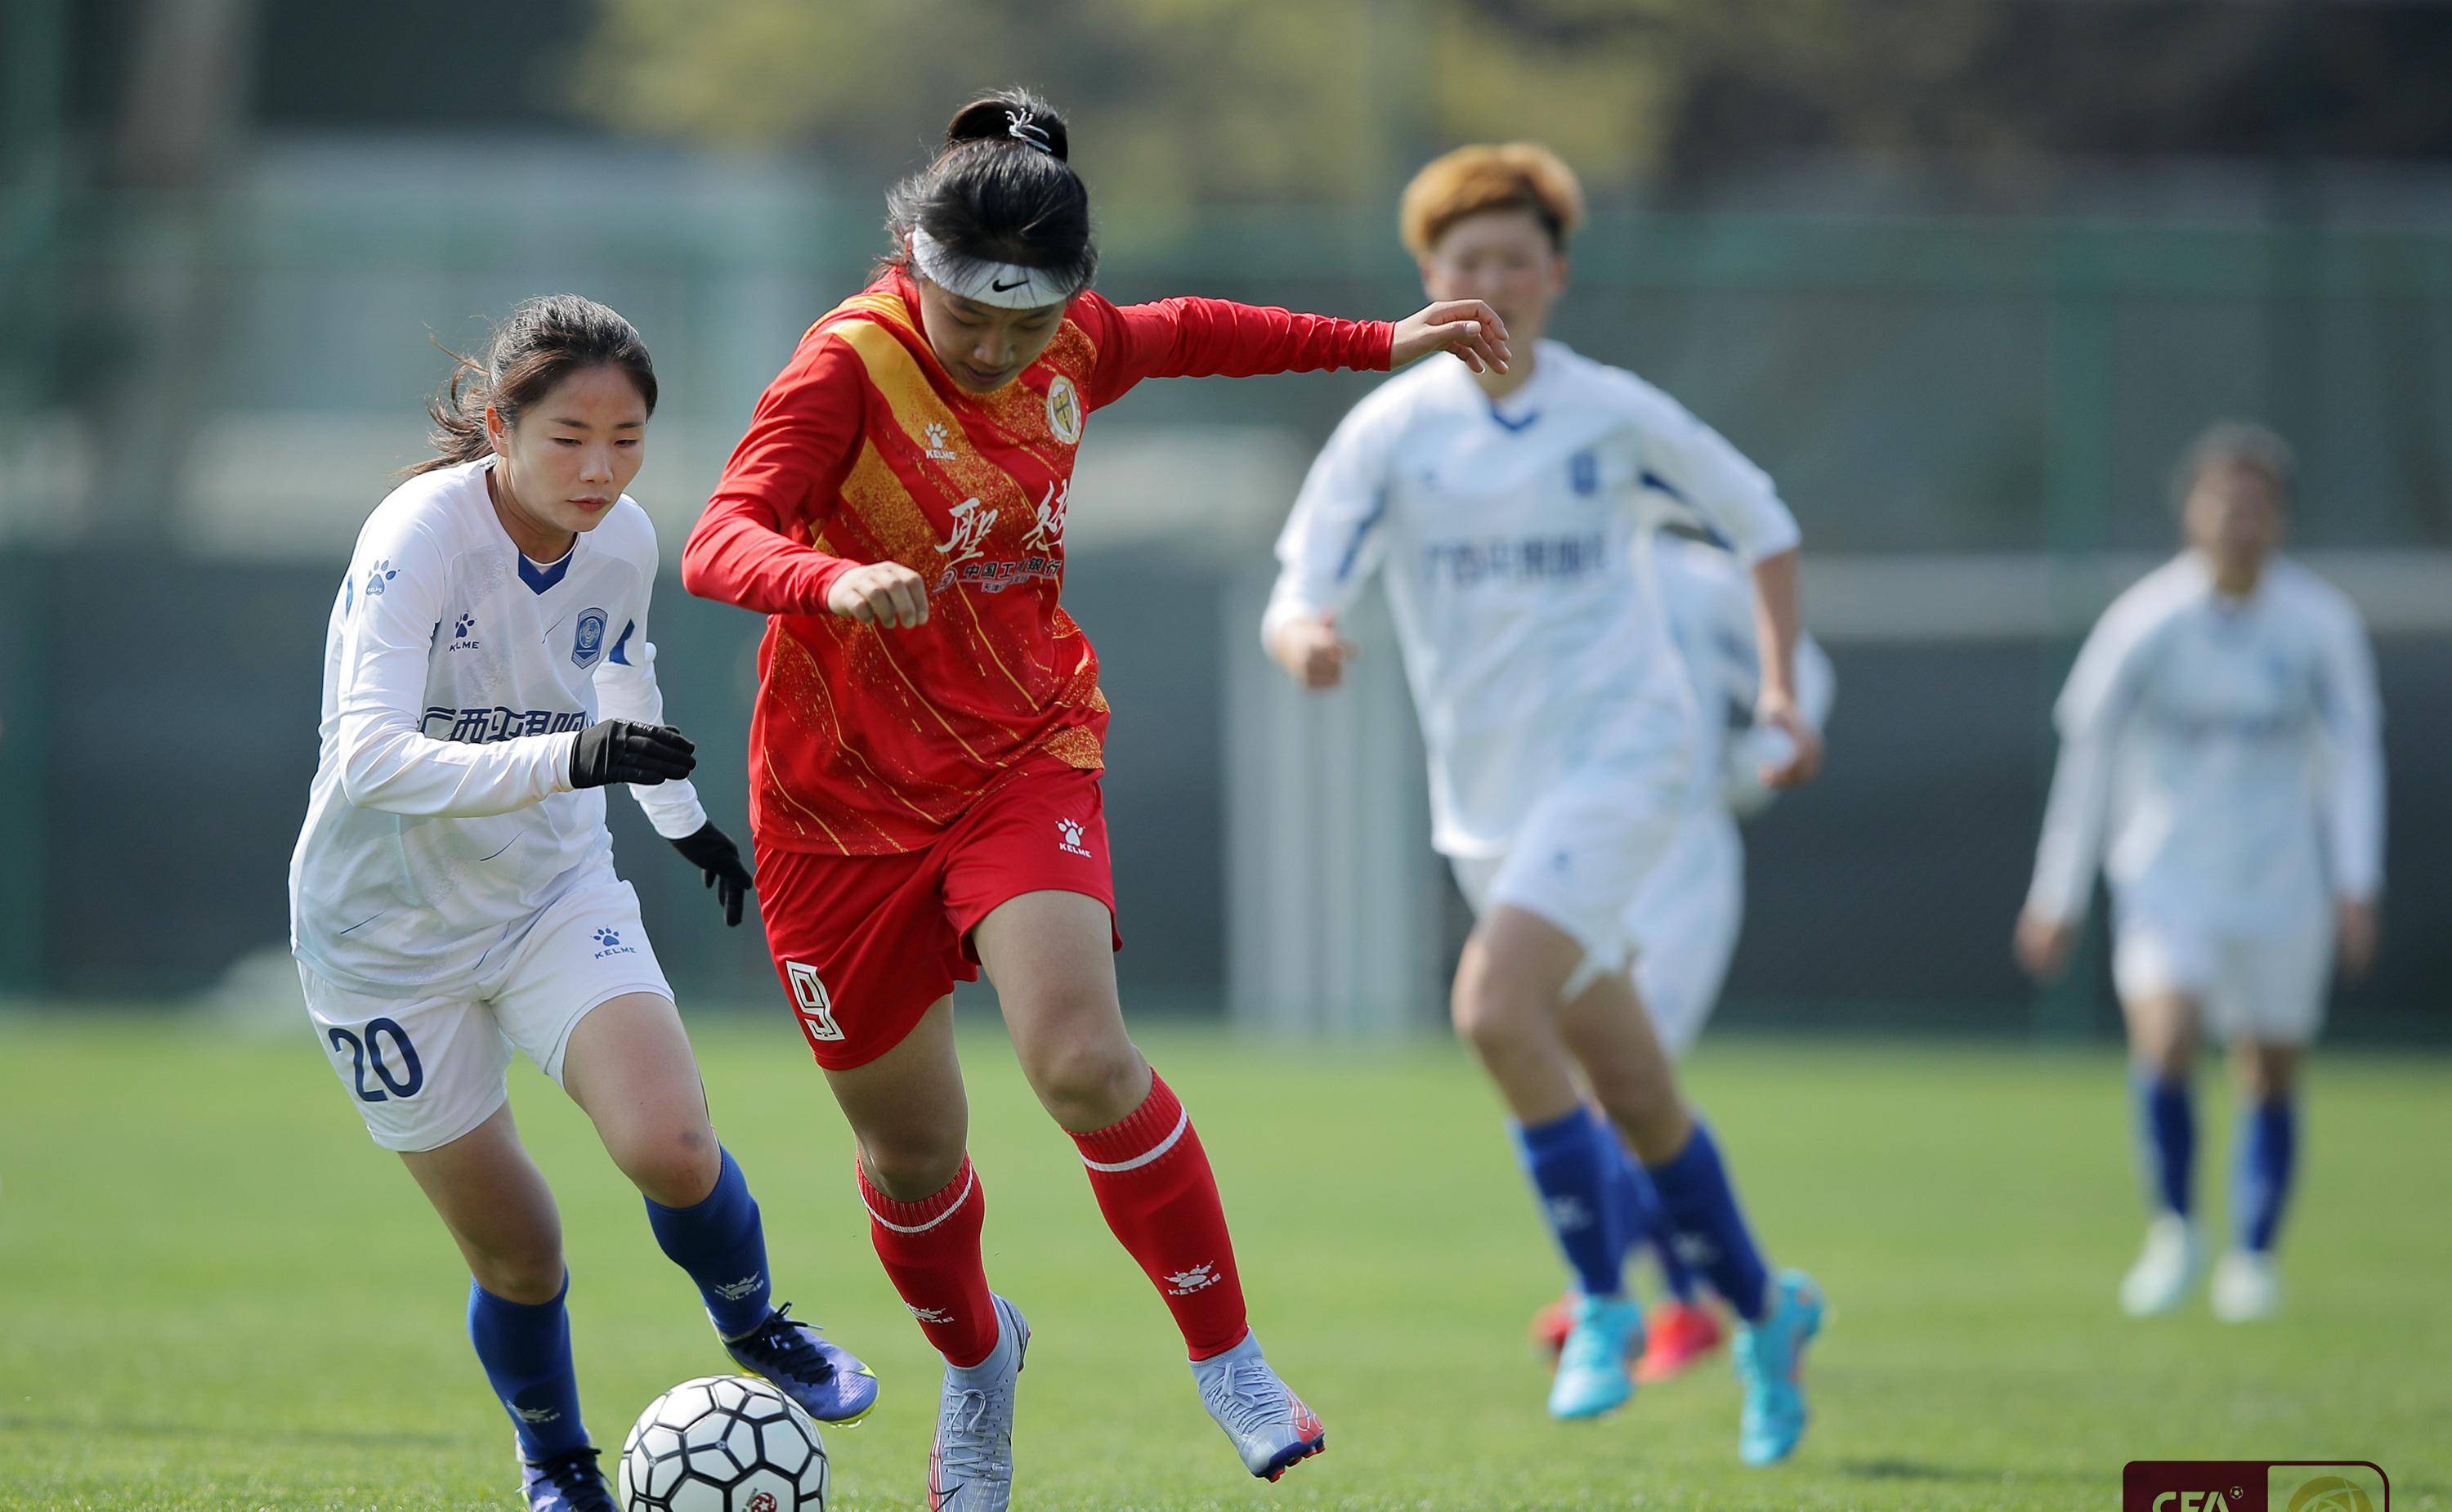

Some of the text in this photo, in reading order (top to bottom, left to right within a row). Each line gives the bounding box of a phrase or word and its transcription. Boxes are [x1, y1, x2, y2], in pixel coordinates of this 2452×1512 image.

[925, 450, 955, 459] KELME
[449, 641, 480, 652] KLME
[1059, 842, 1092, 858] KELME
[595, 946, 637, 960] KELME
[785, 960, 845, 1040] 9
[329, 1018, 423, 1102] 20
[1167, 1273, 1221, 1295] KELME
